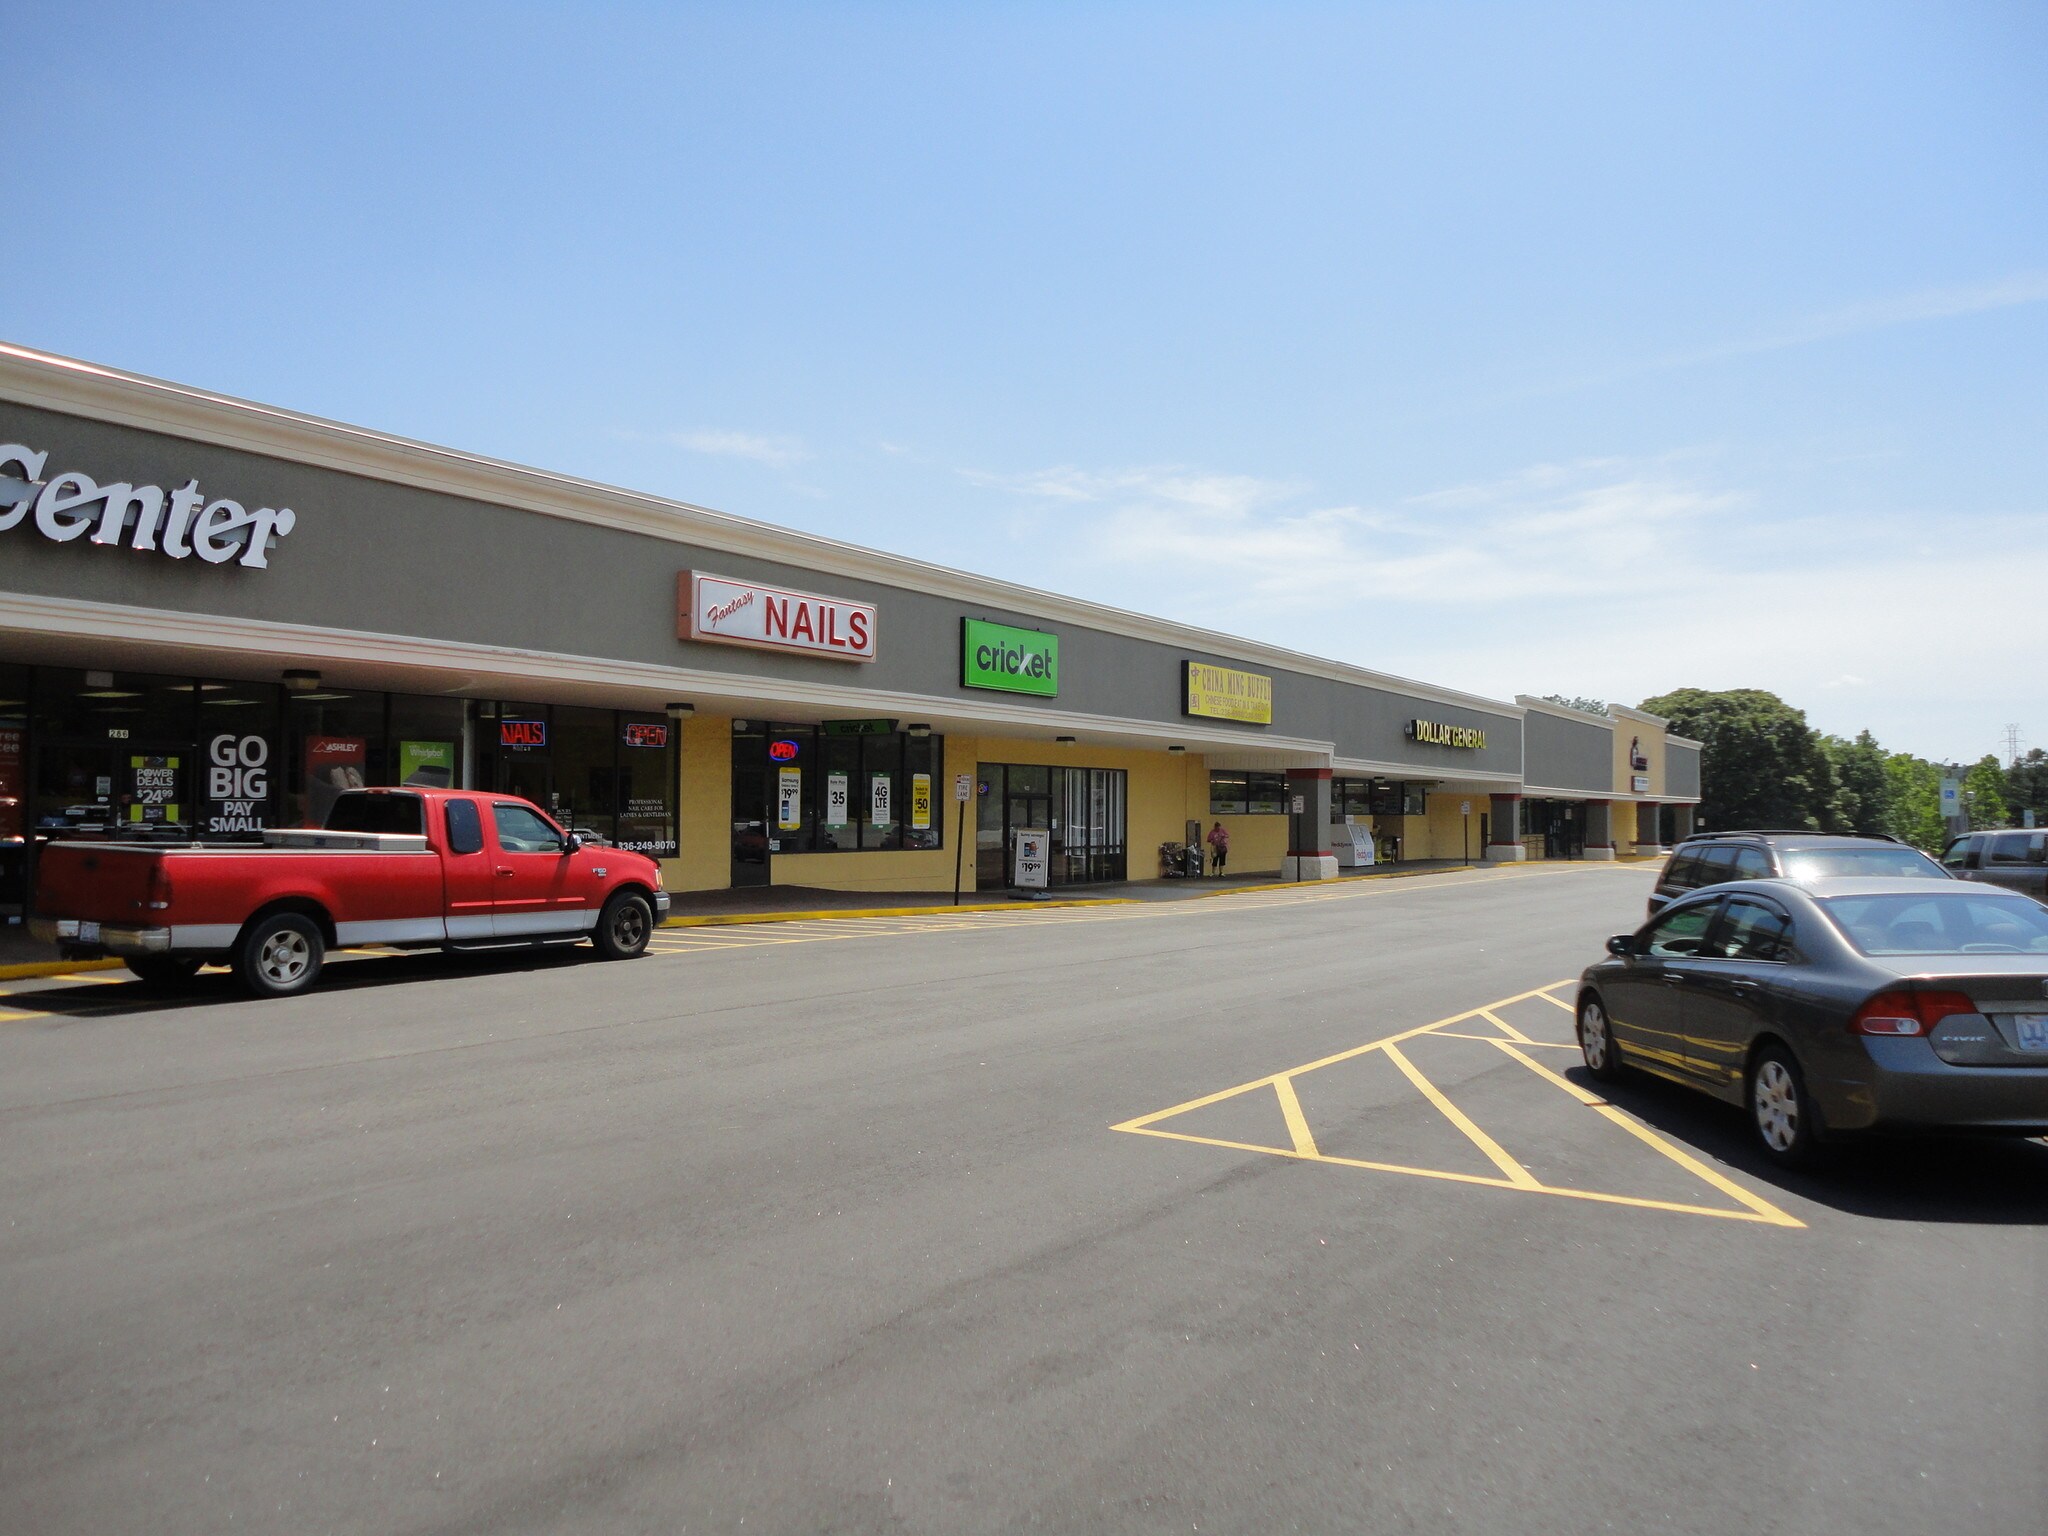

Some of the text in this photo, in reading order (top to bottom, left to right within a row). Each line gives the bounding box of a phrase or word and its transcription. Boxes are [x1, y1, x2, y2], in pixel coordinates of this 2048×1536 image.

[0, 443, 296, 569] Center
[707, 590, 868, 650] Fantasy NAILS
[976, 640, 1052, 680] cricket
[1202, 667, 1224, 693] CHINA
[1227, 671, 1245, 697] MING
[501, 723, 543, 744] NAILS
[629, 725, 667, 745] OPEN
[840, 722, 874, 733] cricket
[1416, 719, 1487, 750] DOLLAR GENERAL
[210, 734, 268, 767] GO
[326, 743, 359, 752] ASHLEY
[772, 741, 796, 758] OPEN
[137, 769, 173, 777] POWER
[137, 777, 173, 786] DEALS
[210, 767, 267, 798] BIG
[875, 786, 888, 797] 4G
[223, 802, 254, 816] PAY
[875, 797, 888, 808] LTE
[209, 817, 266, 832] SMALL
